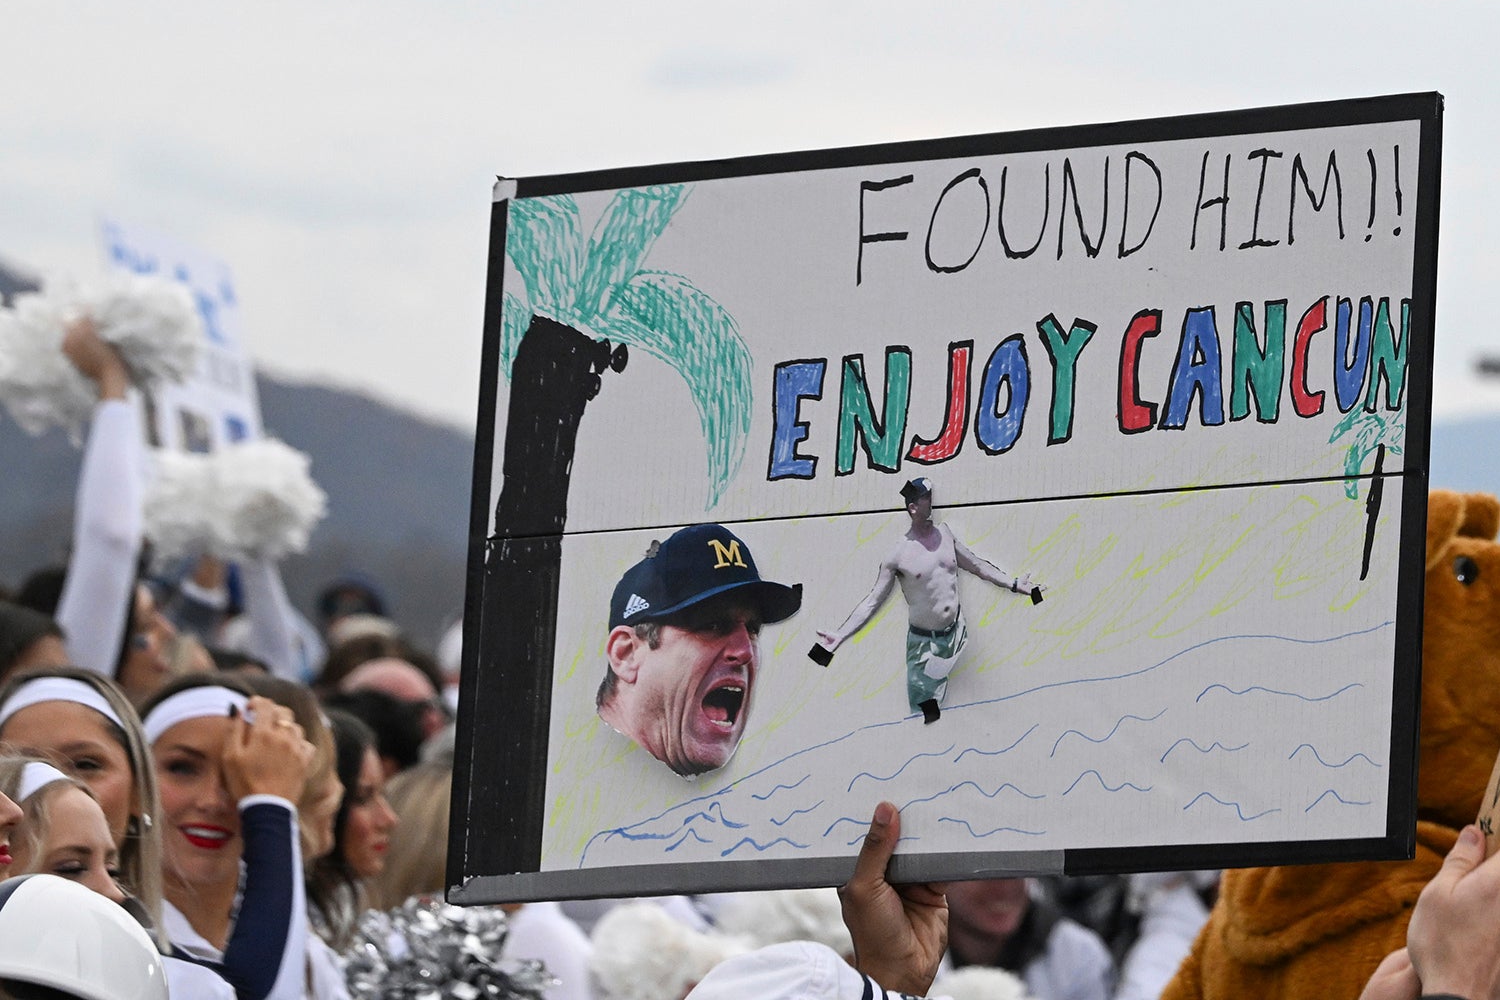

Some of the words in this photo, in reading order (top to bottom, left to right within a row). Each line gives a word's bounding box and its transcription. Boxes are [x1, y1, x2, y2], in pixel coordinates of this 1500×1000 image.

[855, 150, 1163, 287] FOUND
[1190, 144, 1404, 252] HIM!!
[766, 312, 1098, 482] ENJOY
[1116, 294, 1412, 434] CANCUN
[707, 539, 748, 570] M
